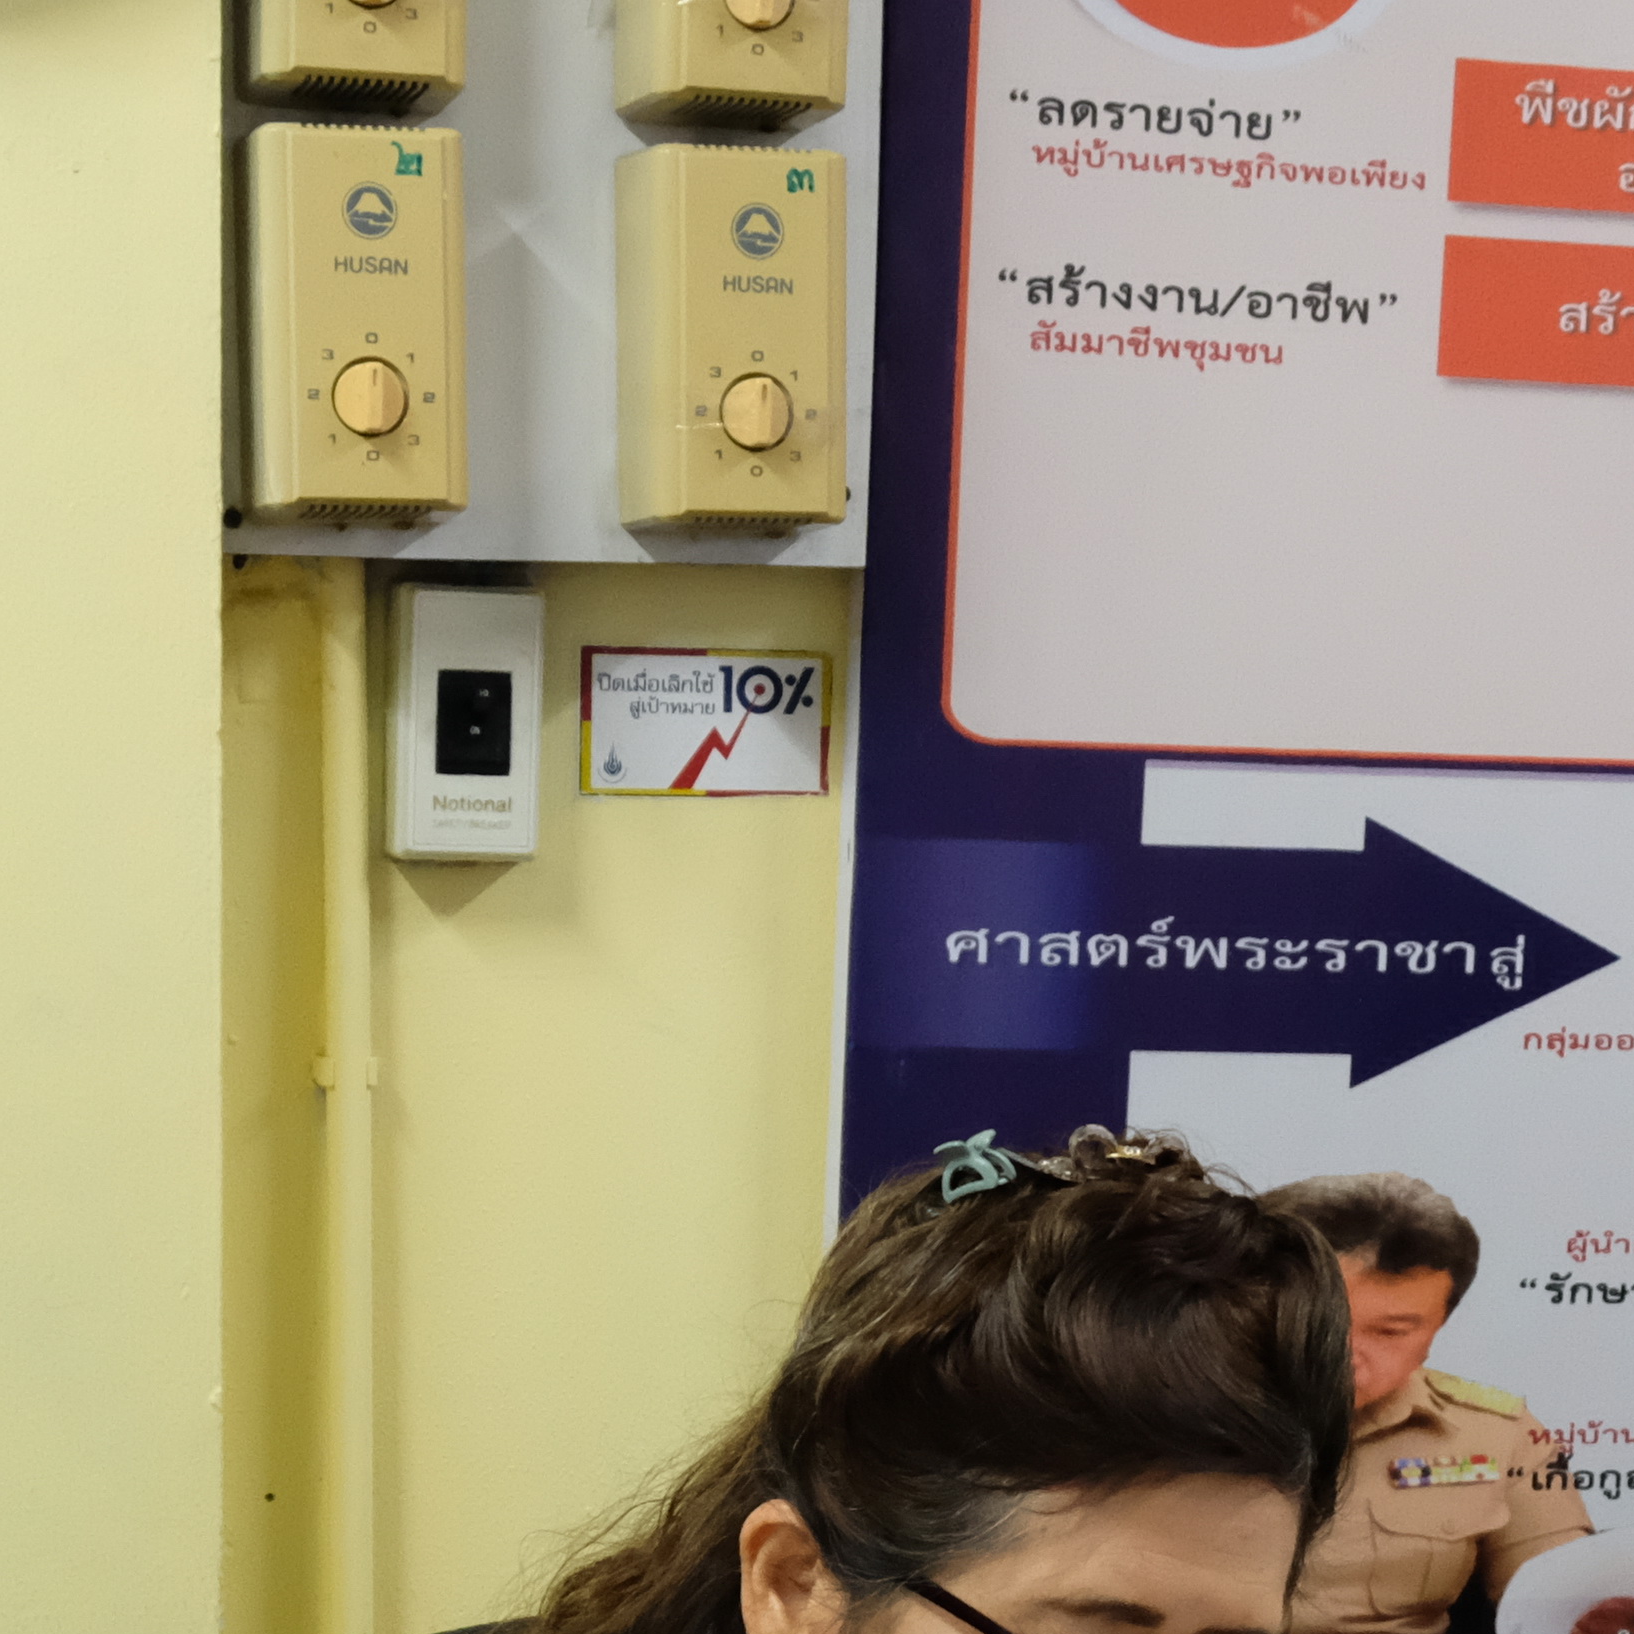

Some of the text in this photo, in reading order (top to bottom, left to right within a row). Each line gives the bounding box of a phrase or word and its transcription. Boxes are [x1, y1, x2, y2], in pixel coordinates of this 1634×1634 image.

[1009, 89, 1301, 142] “ลดรายจ่าย”
[1032, 141, 1427, 193] หมู่บ้านเศรษฐกิจพอเพียง
[334, 256, 409, 275] HUSAN
[723, 275, 794, 295] HUSAN
[997, 266, 1397, 328] “สร้างงาน/อาชีพ”
[1028, 324, 1284, 371] สัมมาชีพชุมชน
[719, 665, 815, 715] 10%
[946, 916, 1526, 991] ศาสตร์พระราชา สู่
